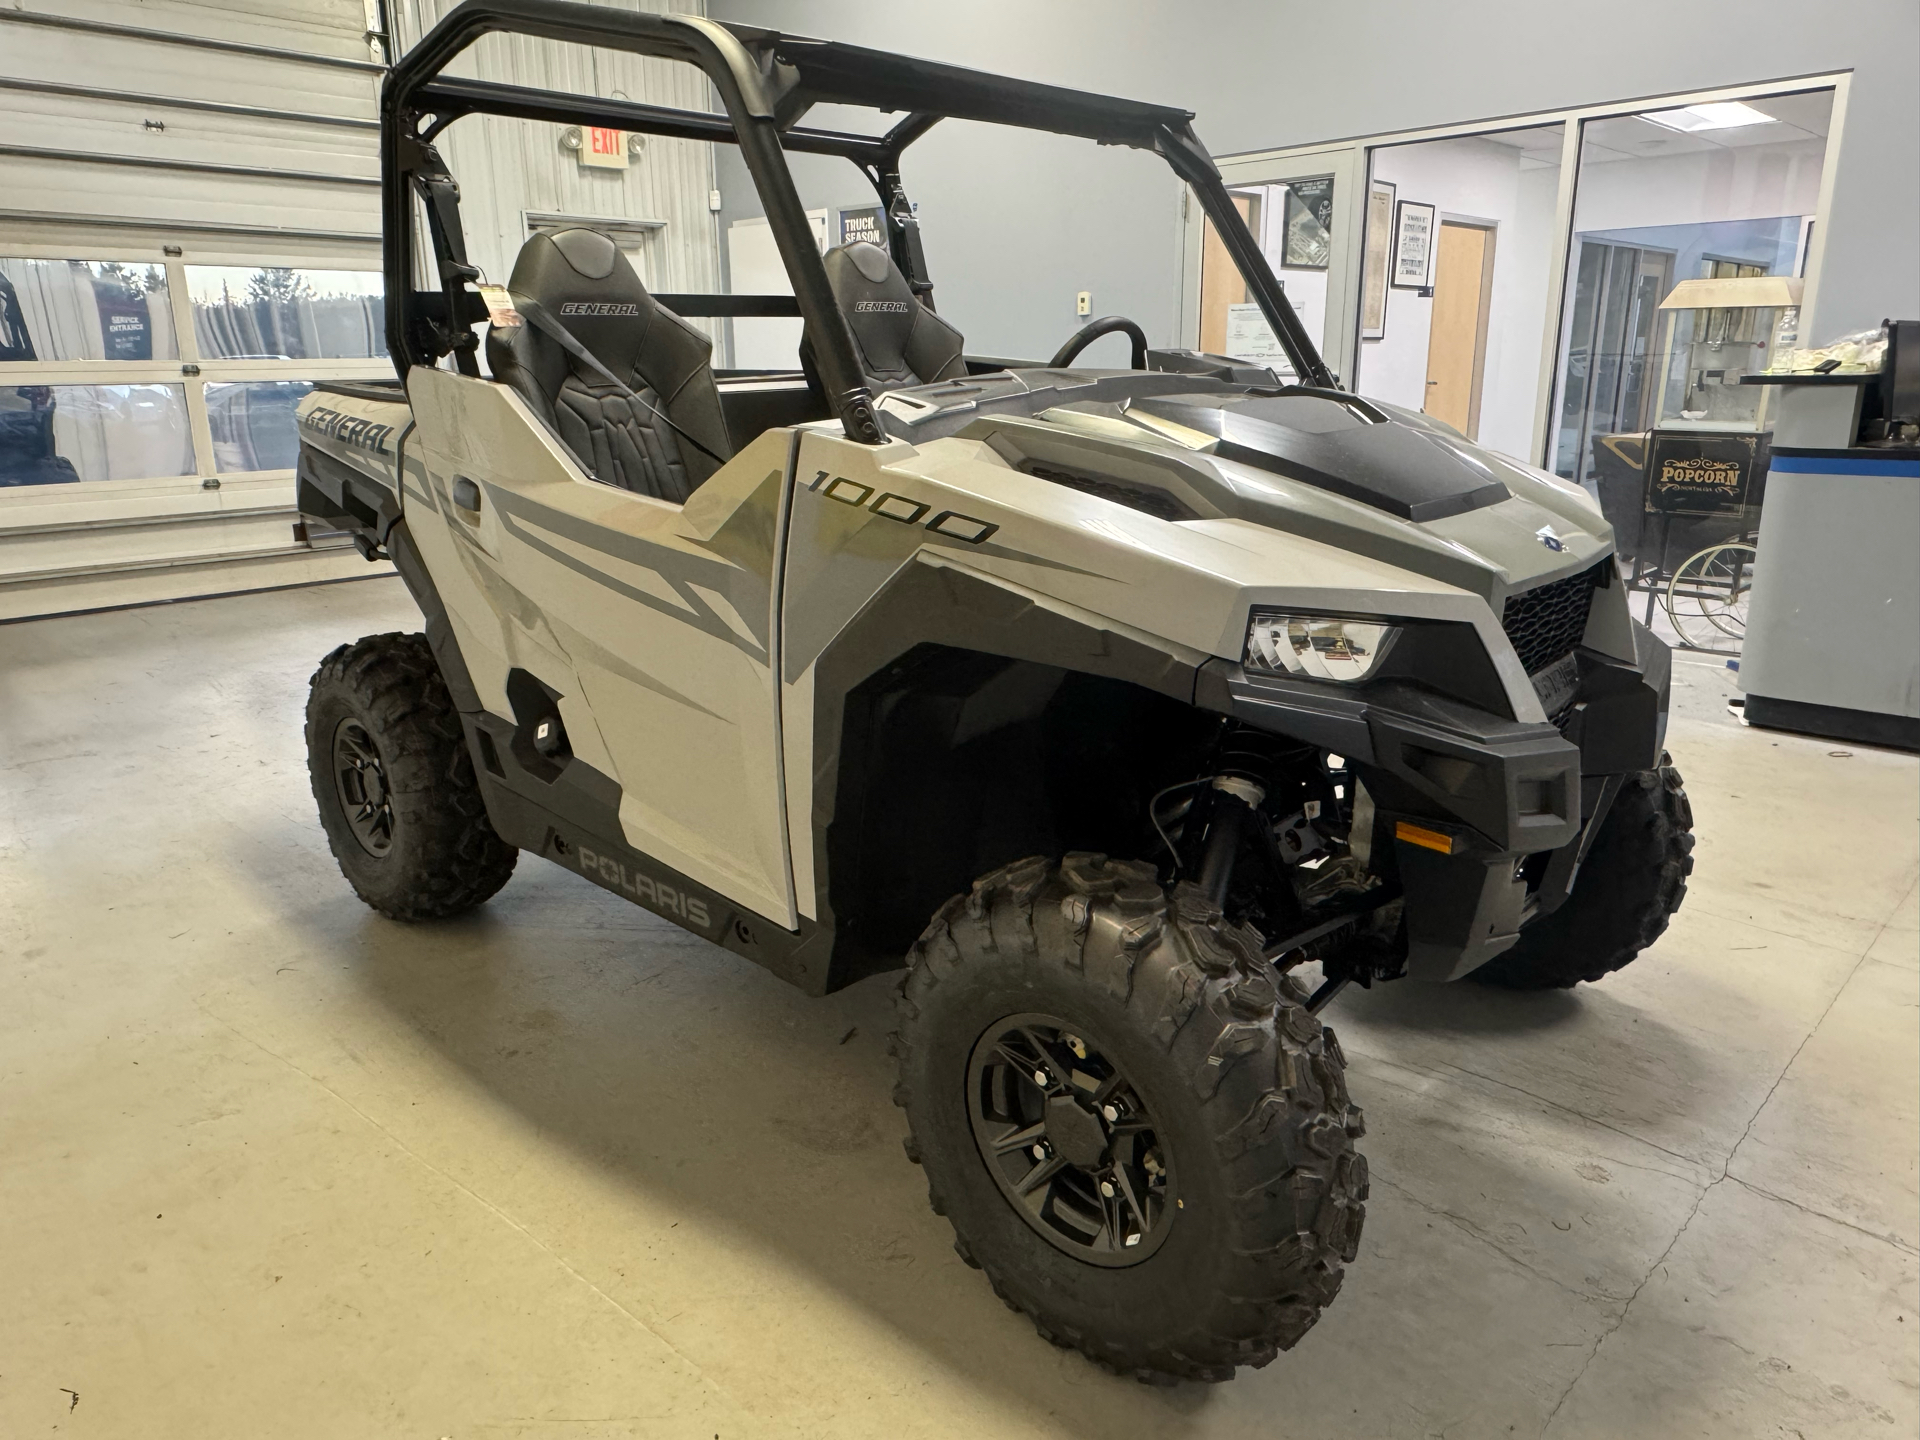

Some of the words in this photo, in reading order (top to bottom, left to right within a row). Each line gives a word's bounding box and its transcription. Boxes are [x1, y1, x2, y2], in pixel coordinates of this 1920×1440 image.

[591, 126, 620, 156] EXIT
[845, 216, 875, 232] TRUCK
[845, 229, 880, 243] SEASON
[560, 302, 639, 316] GENERAL
[855, 301, 908, 313] GENERAL
[109, 323, 144, 332] ENTRANCE
[111, 315, 140, 324] SERVICE
[304, 406, 395, 457] GENERAL
[1660, 466, 1741, 486] POPCORN
[808, 470, 1000, 545] 1000
[578, 846, 711, 928] POLARIS
